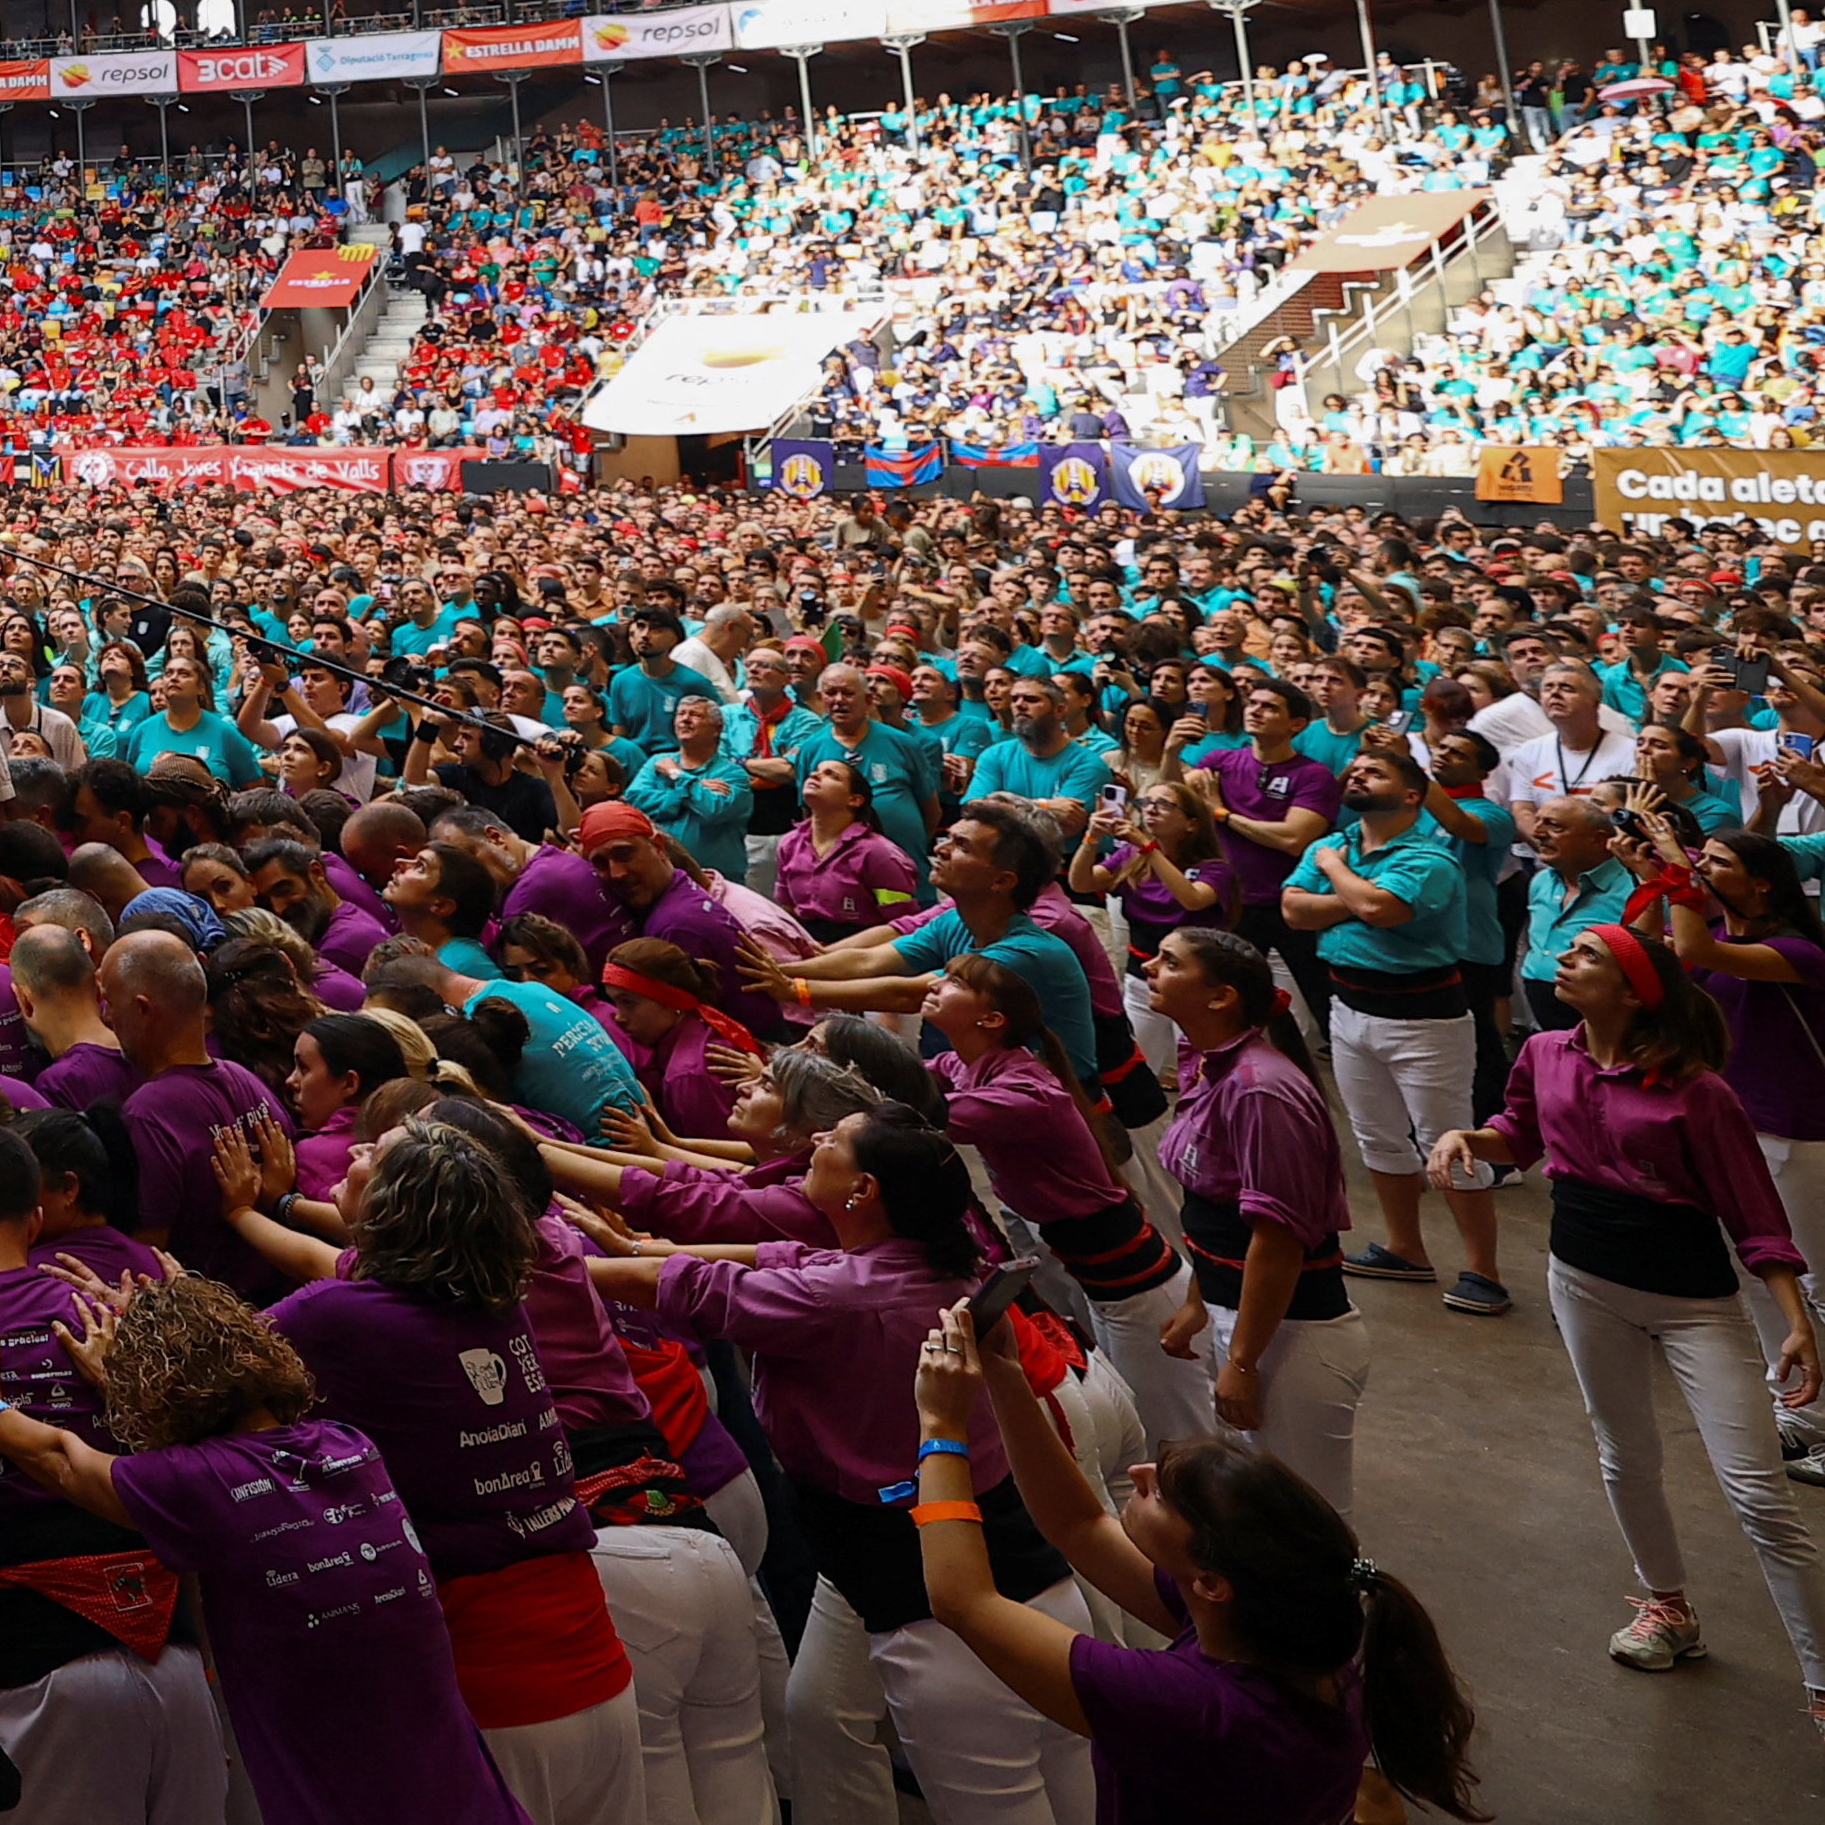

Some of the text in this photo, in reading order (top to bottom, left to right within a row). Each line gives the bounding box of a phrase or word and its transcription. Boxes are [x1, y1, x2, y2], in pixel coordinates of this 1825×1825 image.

[641, 21, 720, 45] repsol
[339, 50, 435, 66] Diputació Tarragona
[464, 35, 579, 59] ESTRELLA DAMM
[101, 63, 170, 84] repsol
[197, 52, 268, 83] 3cat
[8, 74, 48, 88] DAMM
[126, 458, 172, 480] Colla
[176, 457, 223, 478] Joves
[228, 458, 297, 484] Xiquets
[304, 460, 327, 478] de
[334, 458, 380, 481] Valls
[1616, 469, 1726, 502] Cada
[508, 1334, 533, 1356] COT
[459, 1418, 528, 1448] AnoiaDiari
